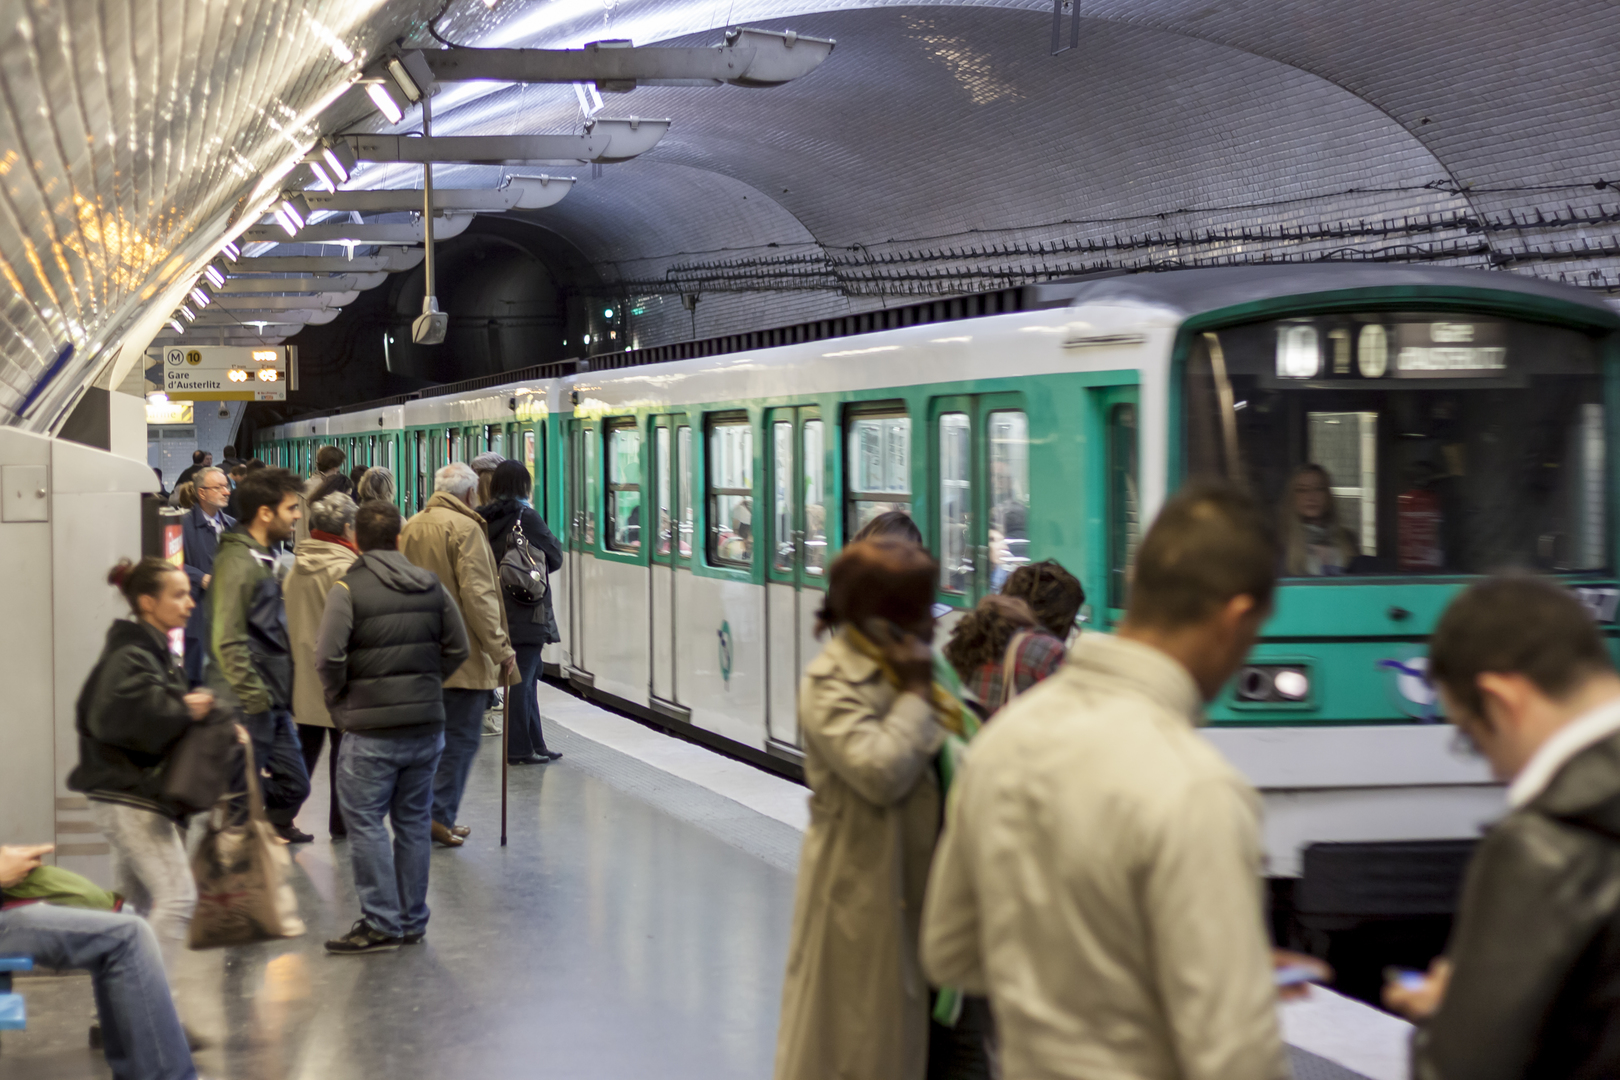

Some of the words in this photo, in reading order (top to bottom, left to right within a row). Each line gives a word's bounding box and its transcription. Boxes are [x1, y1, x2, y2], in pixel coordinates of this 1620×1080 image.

[187, 352, 200, 363] 10
[168, 371, 190, 379] Gare
[168, 380, 221, 389] d'Austerlitz
